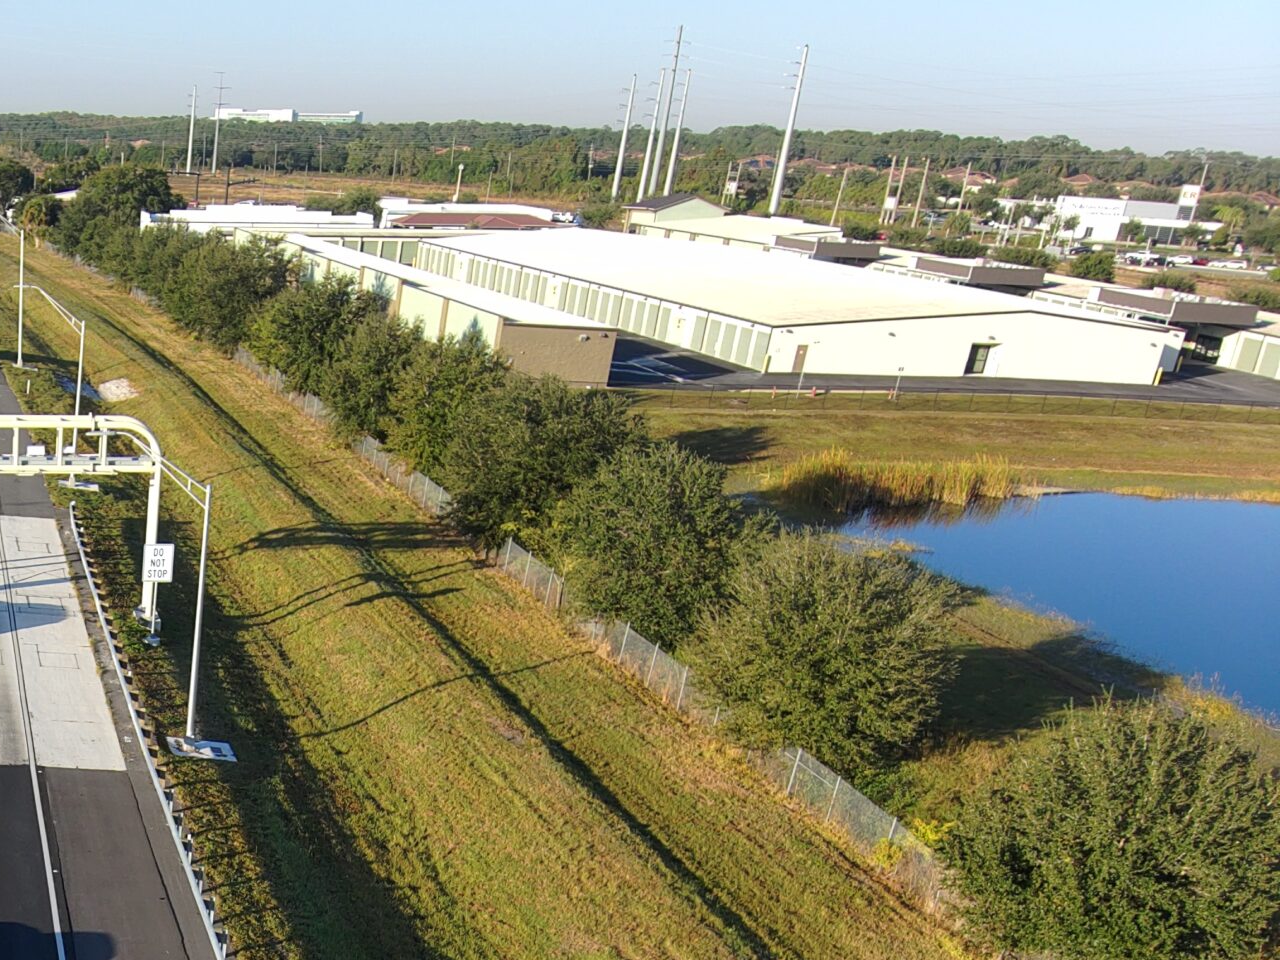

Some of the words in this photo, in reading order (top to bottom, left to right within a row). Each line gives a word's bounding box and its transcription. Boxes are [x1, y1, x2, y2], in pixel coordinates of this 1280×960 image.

[1183, 191, 1197, 199] ER
[153, 548, 164, 557] DO
[150, 558, 165, 567] NOT
[147, 569, 168, 578] STOP
